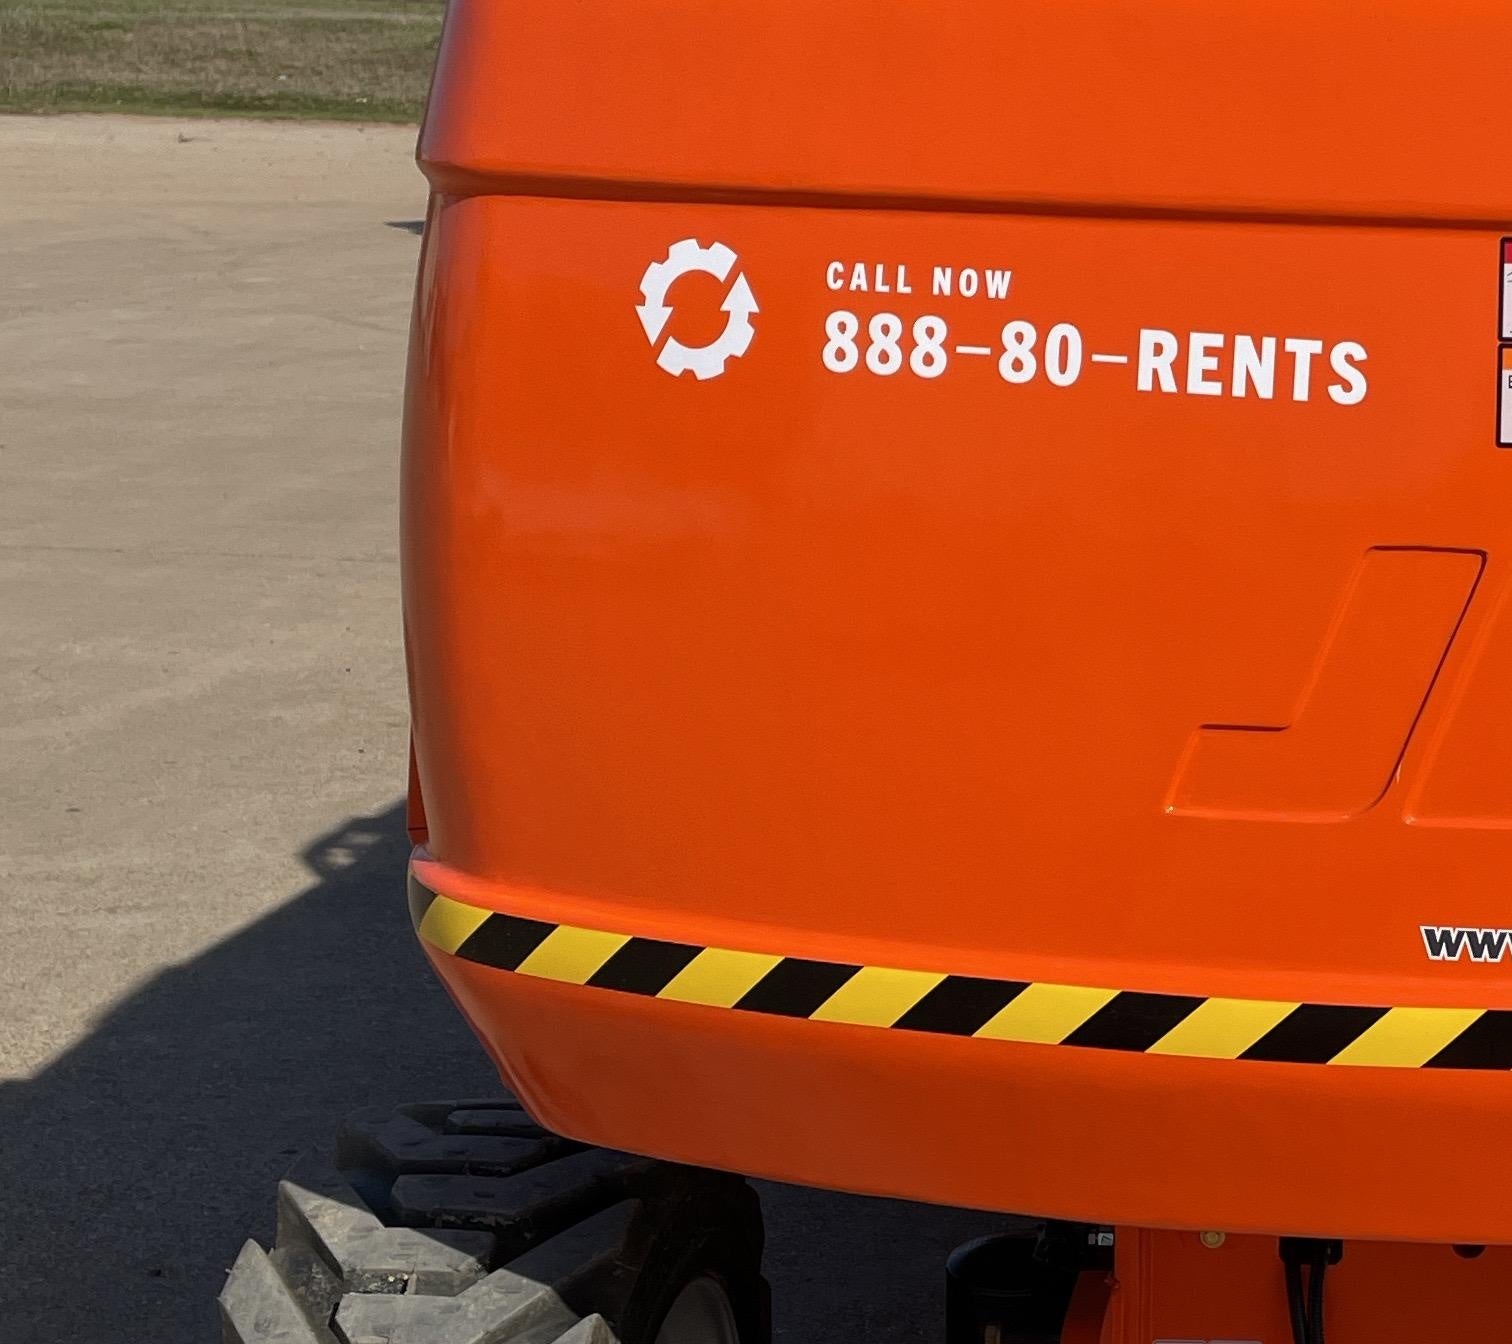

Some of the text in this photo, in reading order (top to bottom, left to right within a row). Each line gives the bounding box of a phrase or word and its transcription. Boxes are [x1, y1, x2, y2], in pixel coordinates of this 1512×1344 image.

[826, 261, 1013, 300] CALL NOW
[822, 309, 1368, 406] 888-80-RENTS
